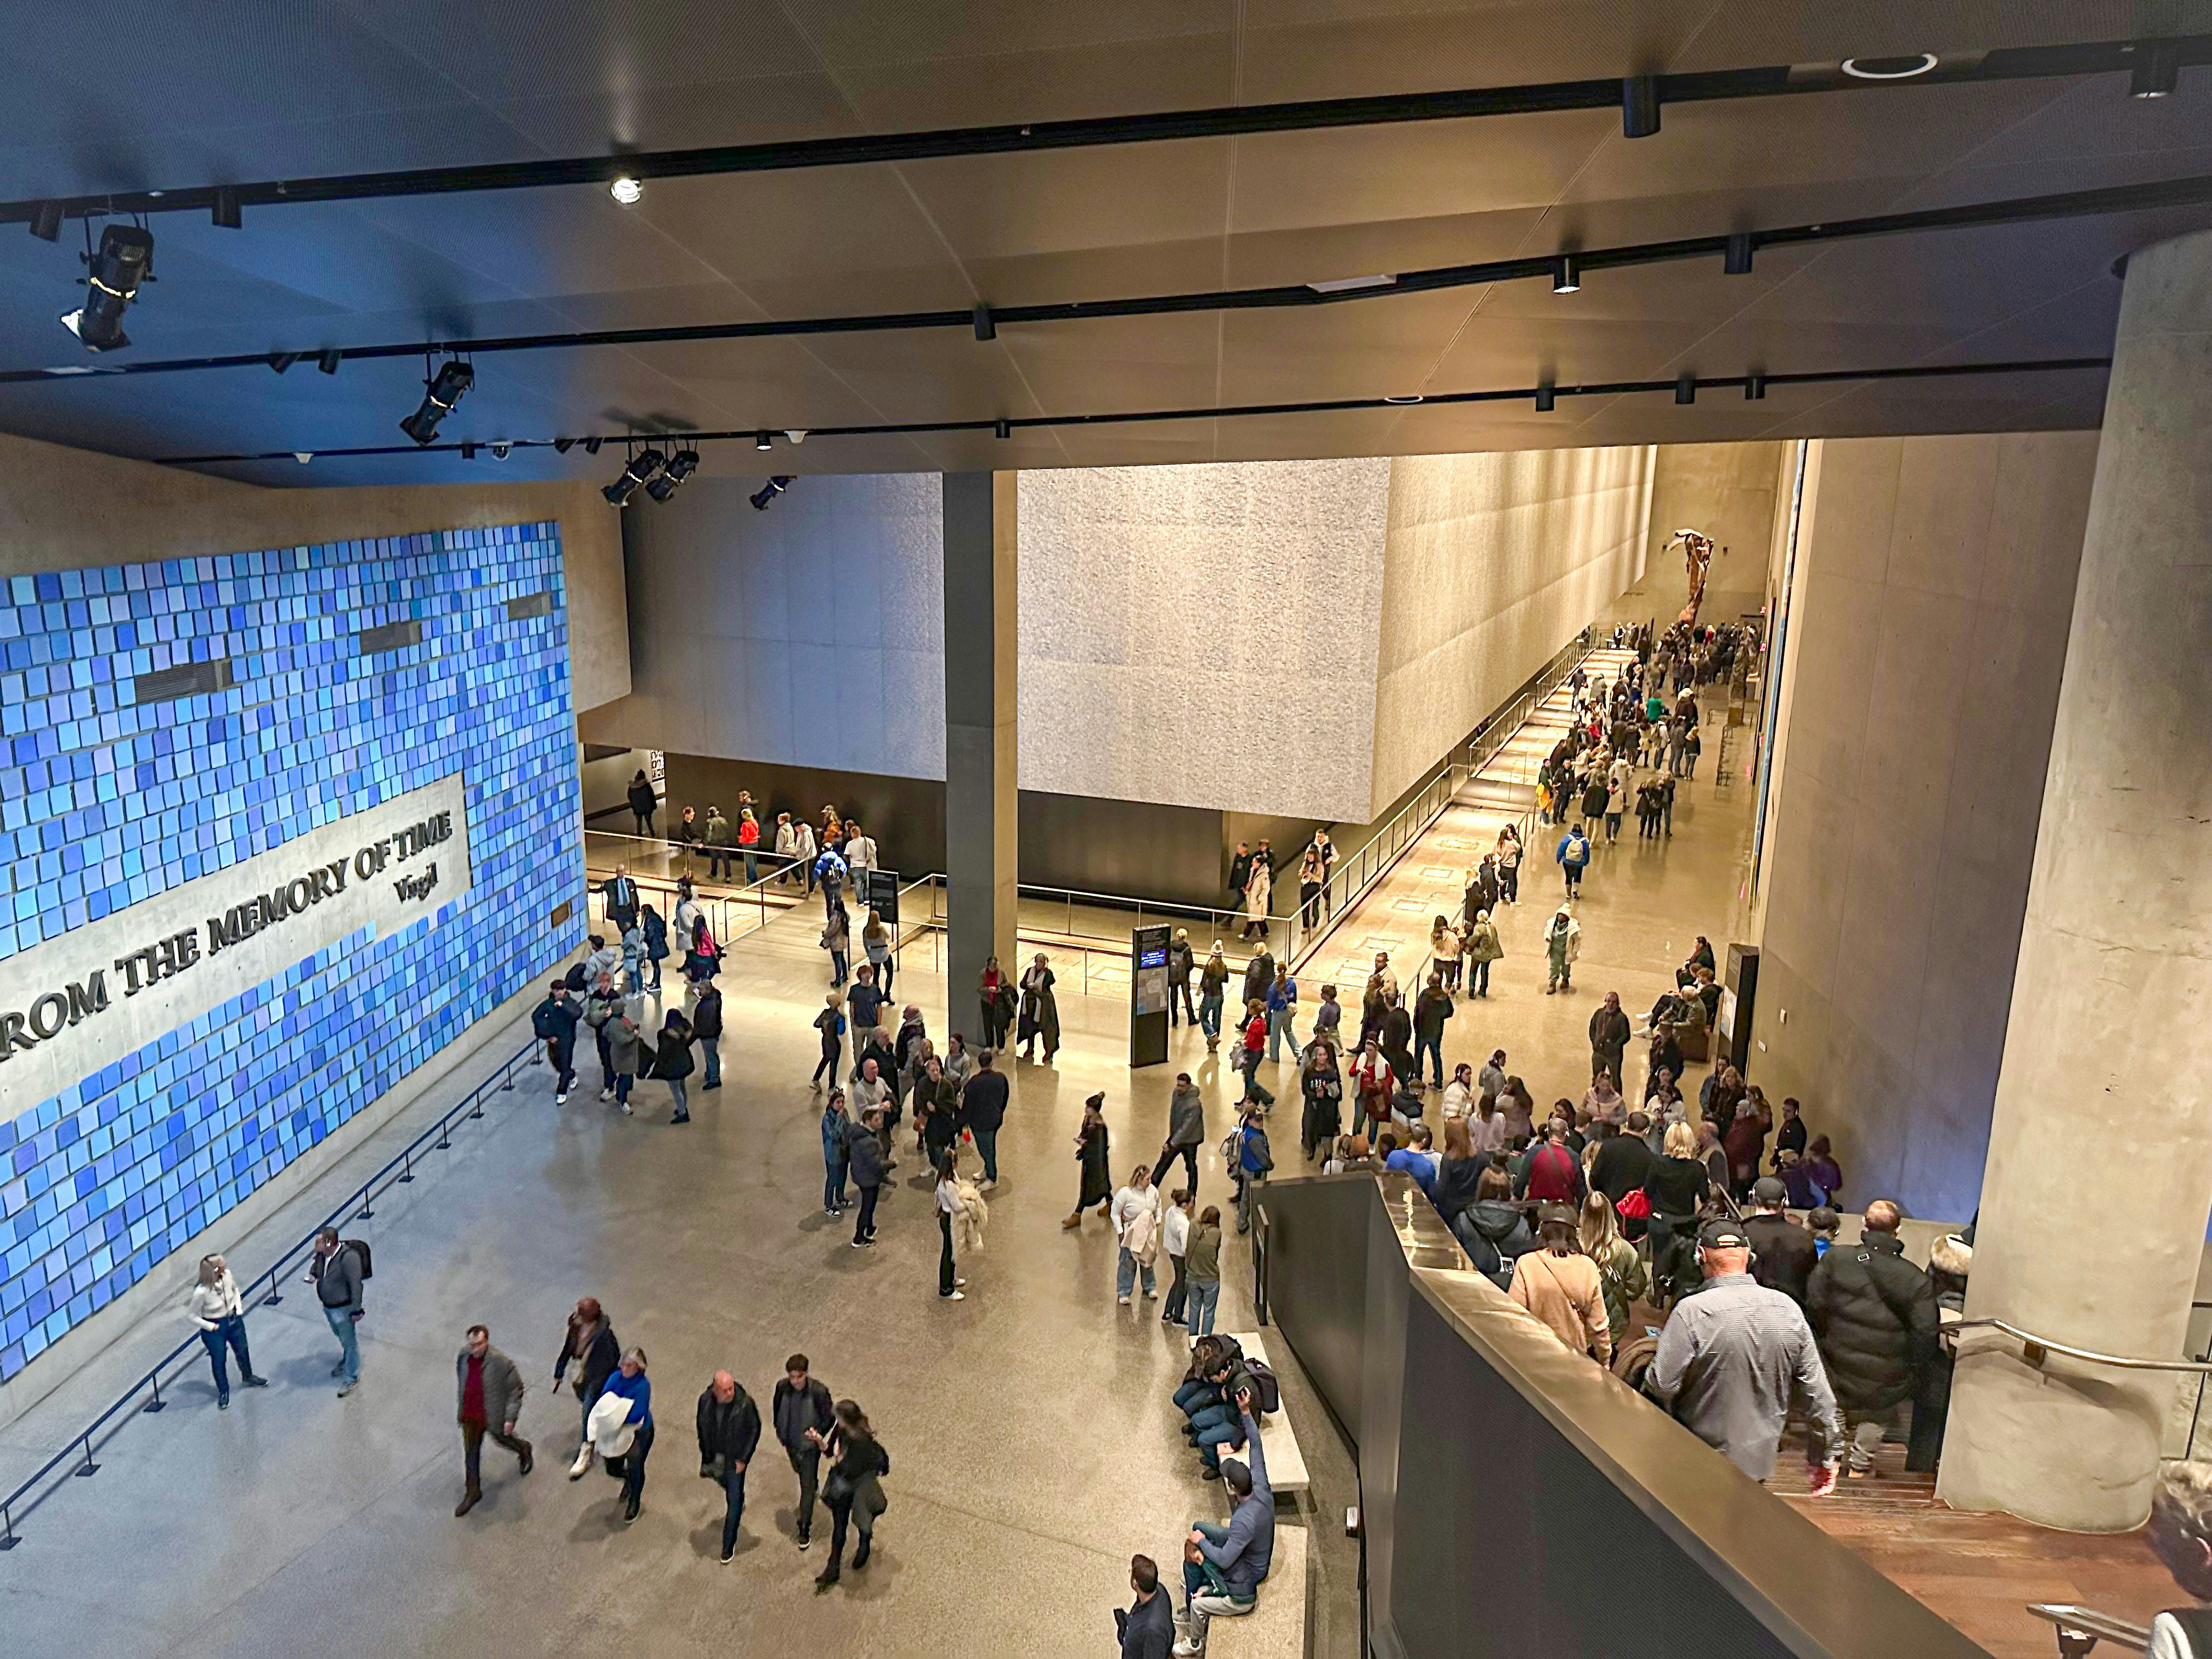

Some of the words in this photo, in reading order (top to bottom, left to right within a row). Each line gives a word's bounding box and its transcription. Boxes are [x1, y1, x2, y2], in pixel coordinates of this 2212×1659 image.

[114, 927, 201, 997] THE
[206, 856, 350, 956] MEMORY
[354, 838, 391, 880] OF
[392, 810, 453, 862] TIME
